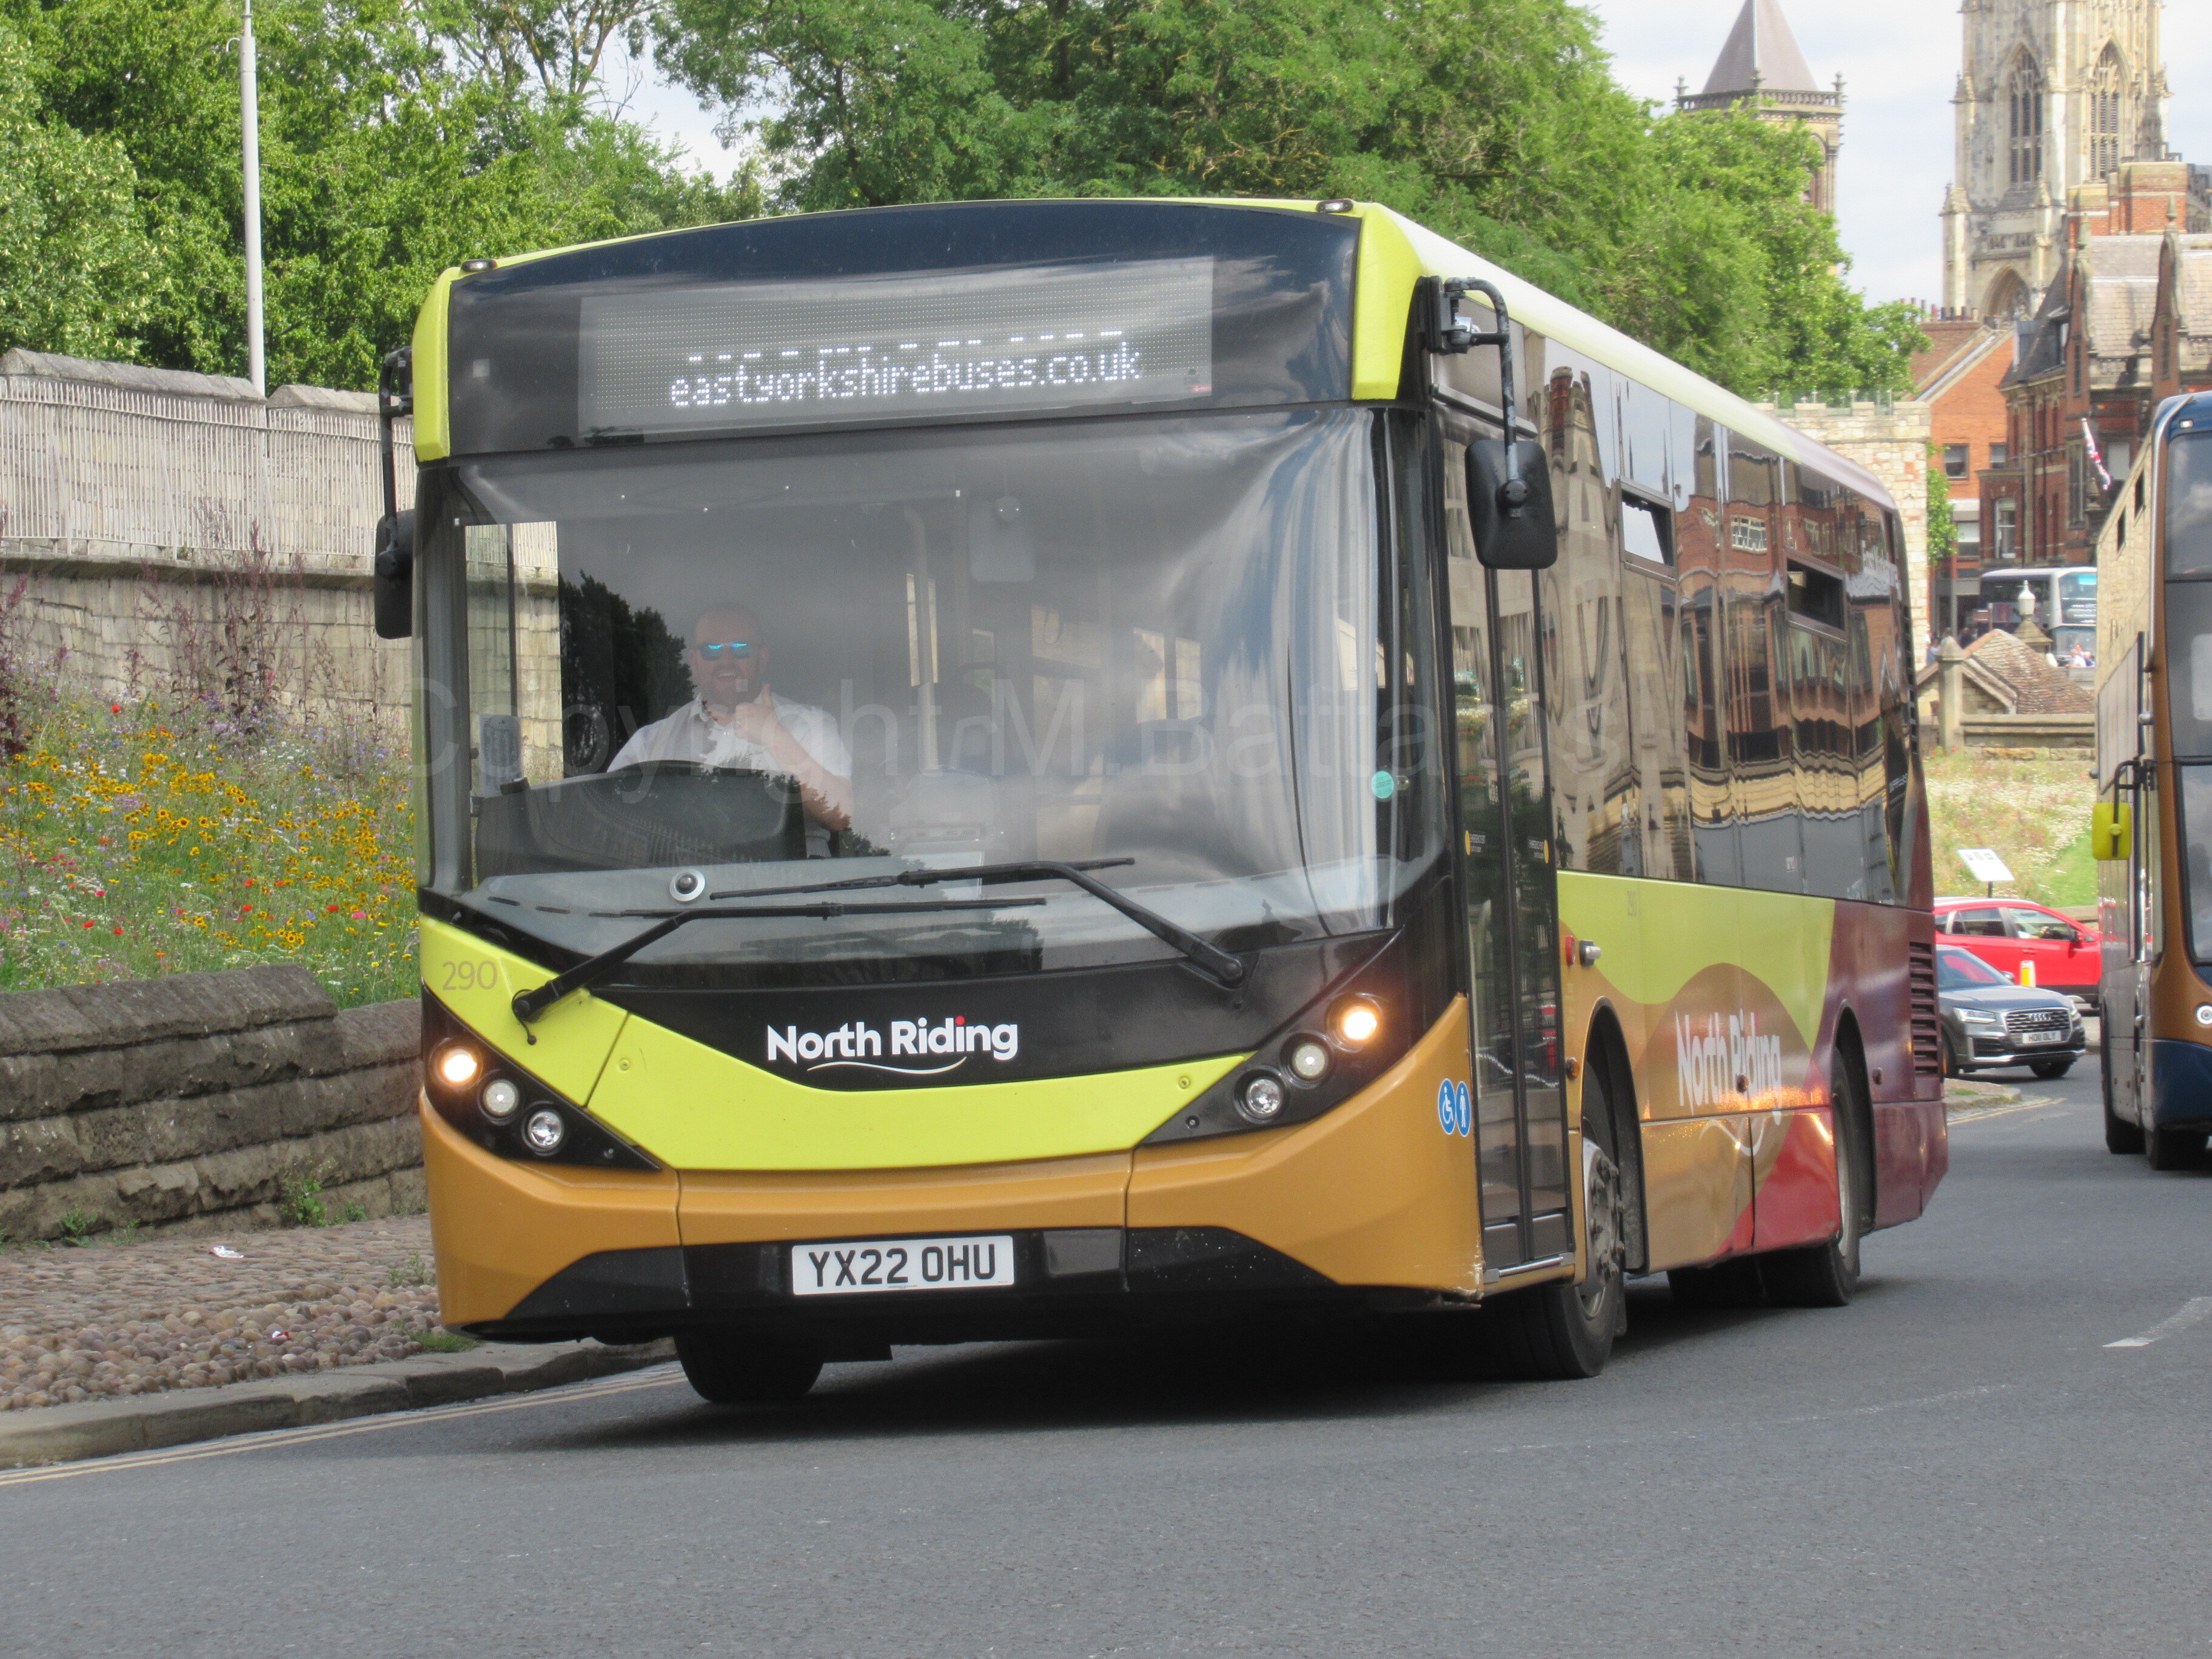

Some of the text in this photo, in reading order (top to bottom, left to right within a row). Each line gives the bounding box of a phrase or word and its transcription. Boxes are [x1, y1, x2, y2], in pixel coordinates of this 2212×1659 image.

[670, 341, 1142, 407] eastyorkshirebuses.co.uk
[443, 961, 497, 990] 290
[768, 1016, 1019, 1064] North Riding
[1675, 1008, 1782, 1126] North Riding
[809, 1244, 996, 1287] YX22 OHU
